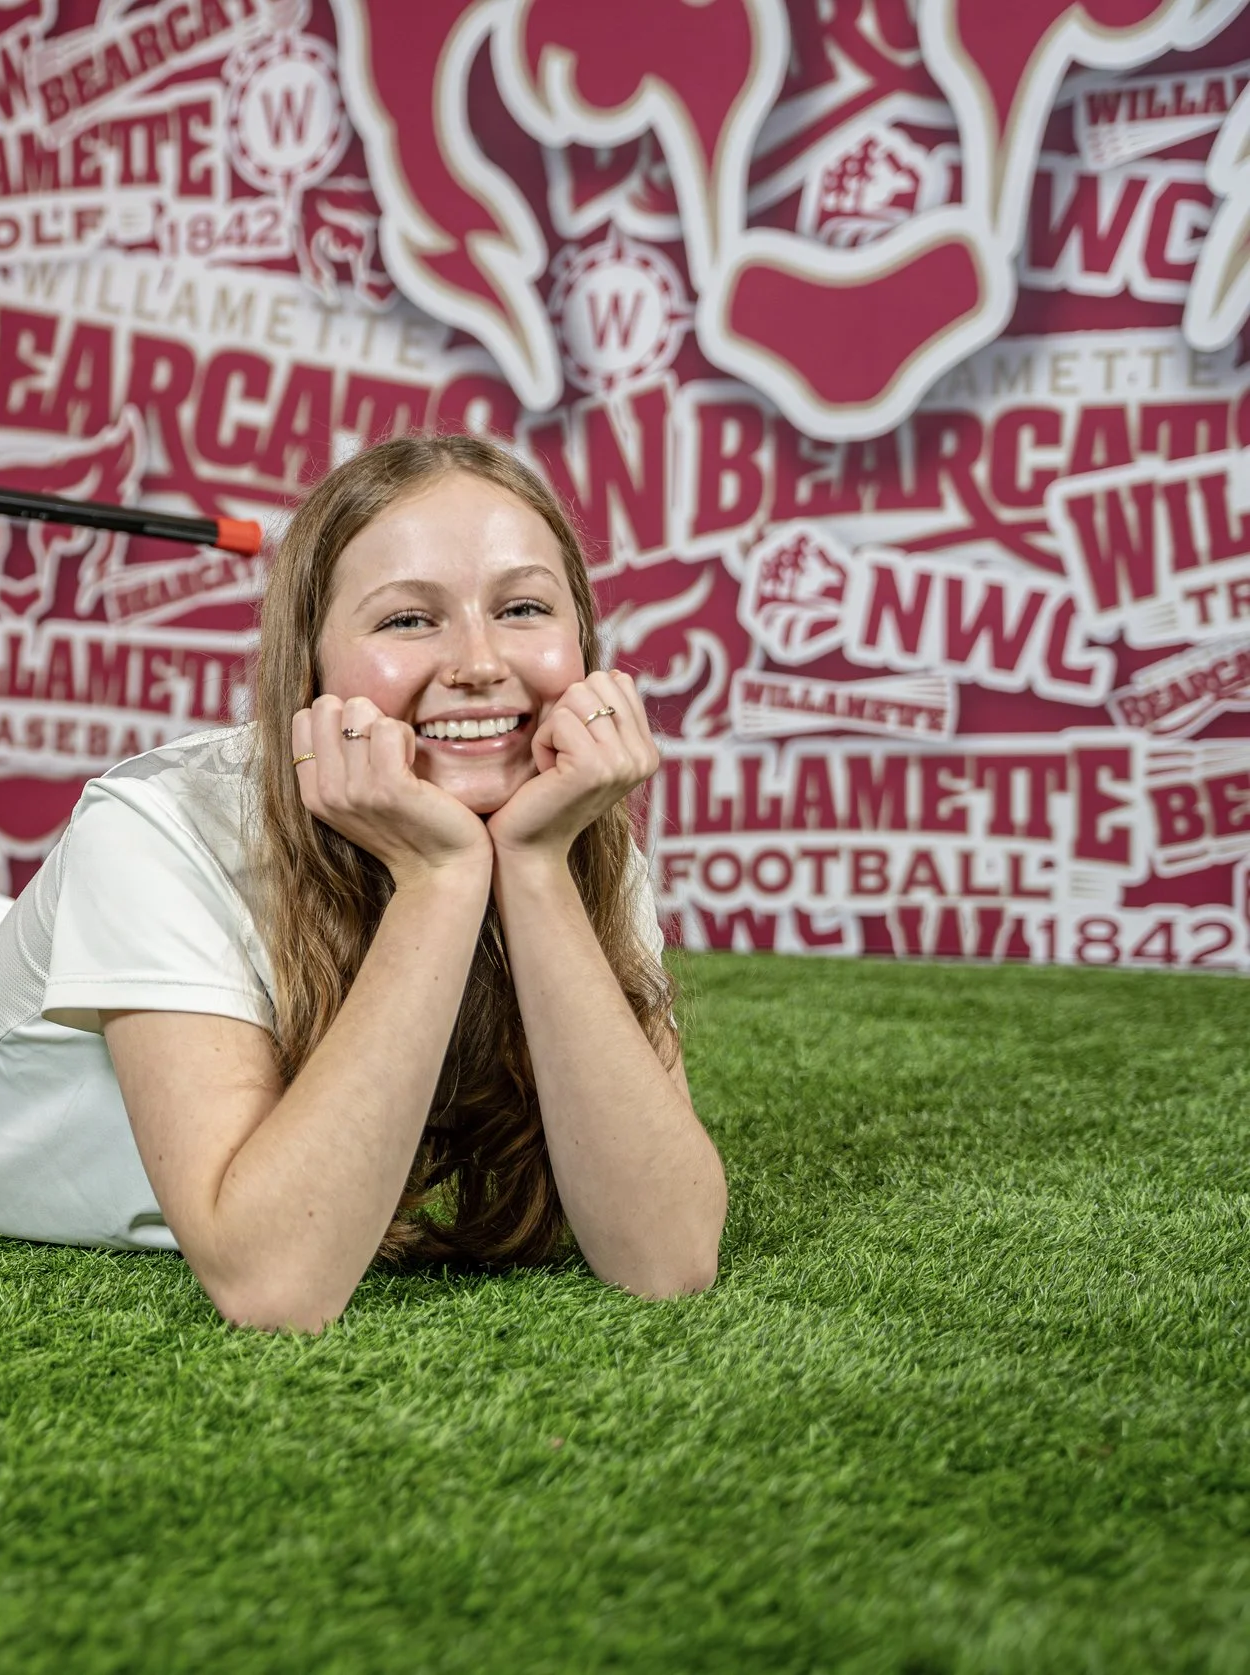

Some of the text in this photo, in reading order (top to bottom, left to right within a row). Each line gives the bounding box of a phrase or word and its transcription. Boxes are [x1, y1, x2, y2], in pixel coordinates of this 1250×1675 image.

[261, 86, 316, 150] W
[166, 207, 282, 256] 1842
[22, 263, 425, 367] WILLAMETTE
[587, 293, 645, 350] W
[692, 400, 1250, 535] BEARCAT
[741, 680, 947, 733] WILLAMETTE
[661, 747, 1133, 866] ILLAMETTE
[663, 850, 1054, 897] FOOTBALL
